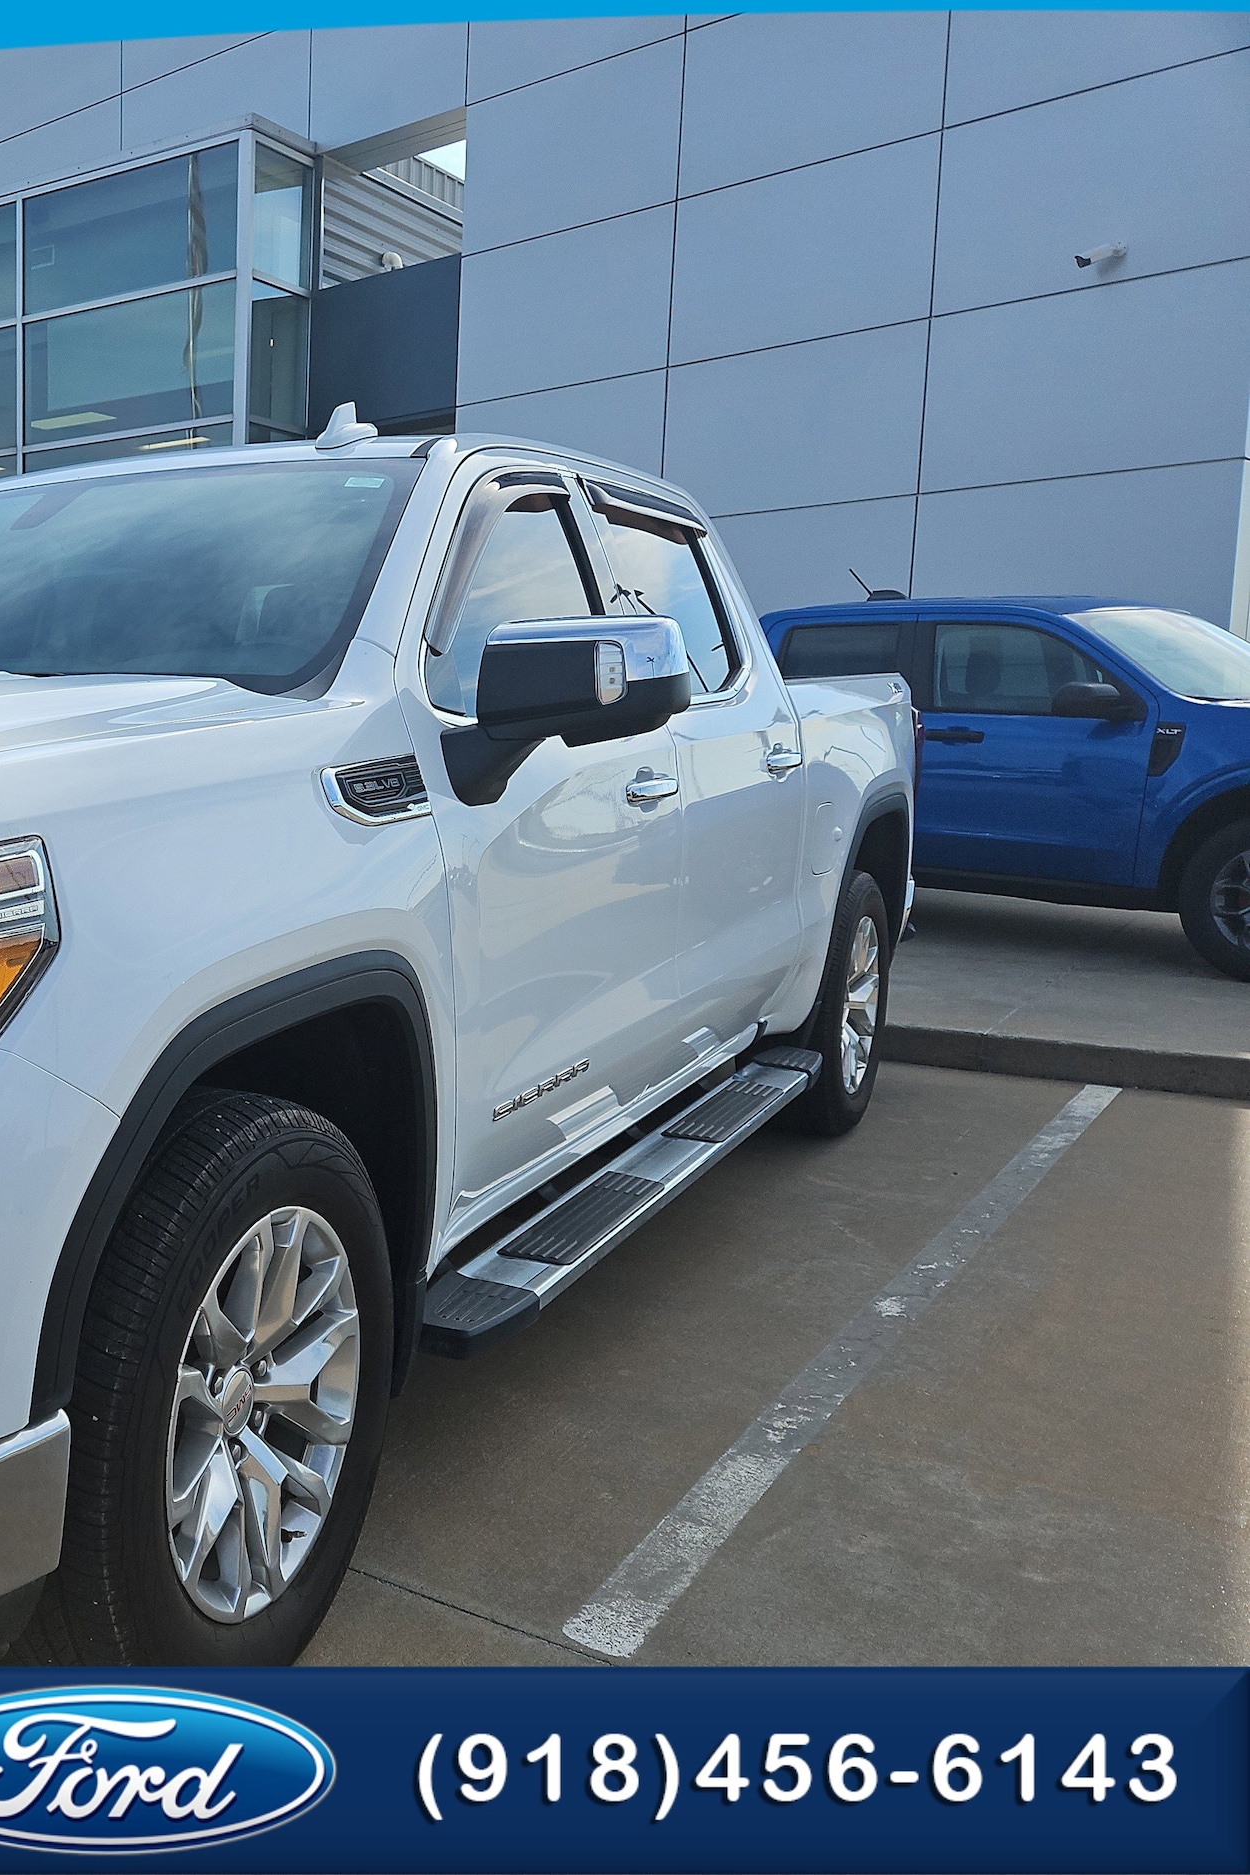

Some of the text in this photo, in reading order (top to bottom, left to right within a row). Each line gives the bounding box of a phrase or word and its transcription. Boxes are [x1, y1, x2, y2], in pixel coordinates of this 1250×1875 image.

[1156, 727, 1182, 735] XLT
[492, 1057, 590, 1121] SIERRA
[177, 1171, 261, 1318] COOPER
